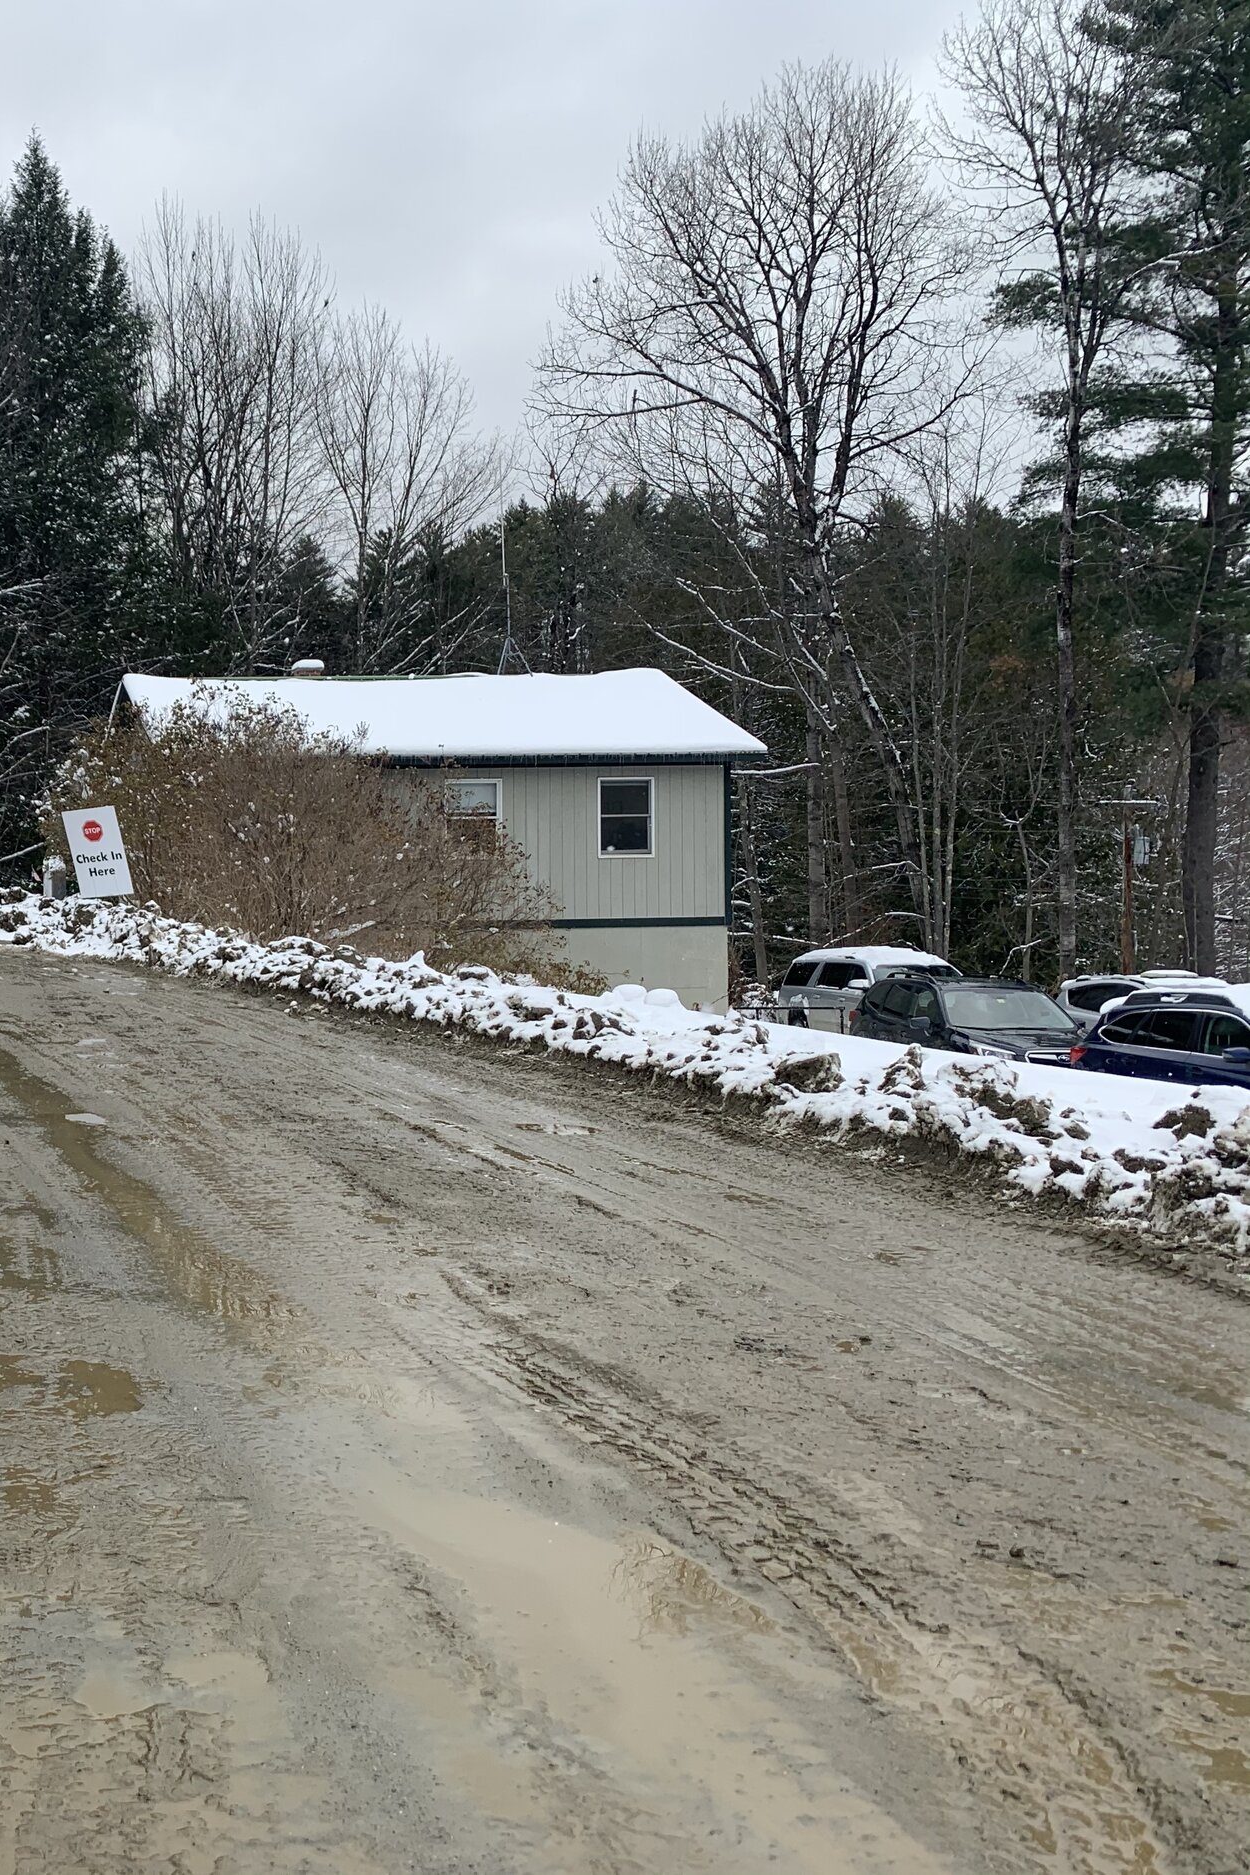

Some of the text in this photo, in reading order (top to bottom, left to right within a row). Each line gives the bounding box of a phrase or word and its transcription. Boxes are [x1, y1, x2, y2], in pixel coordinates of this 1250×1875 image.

[84, 826, 101, 834] STOP
[76, 851, 123, 864] Check In
[89, 867, 116, 877] Here
